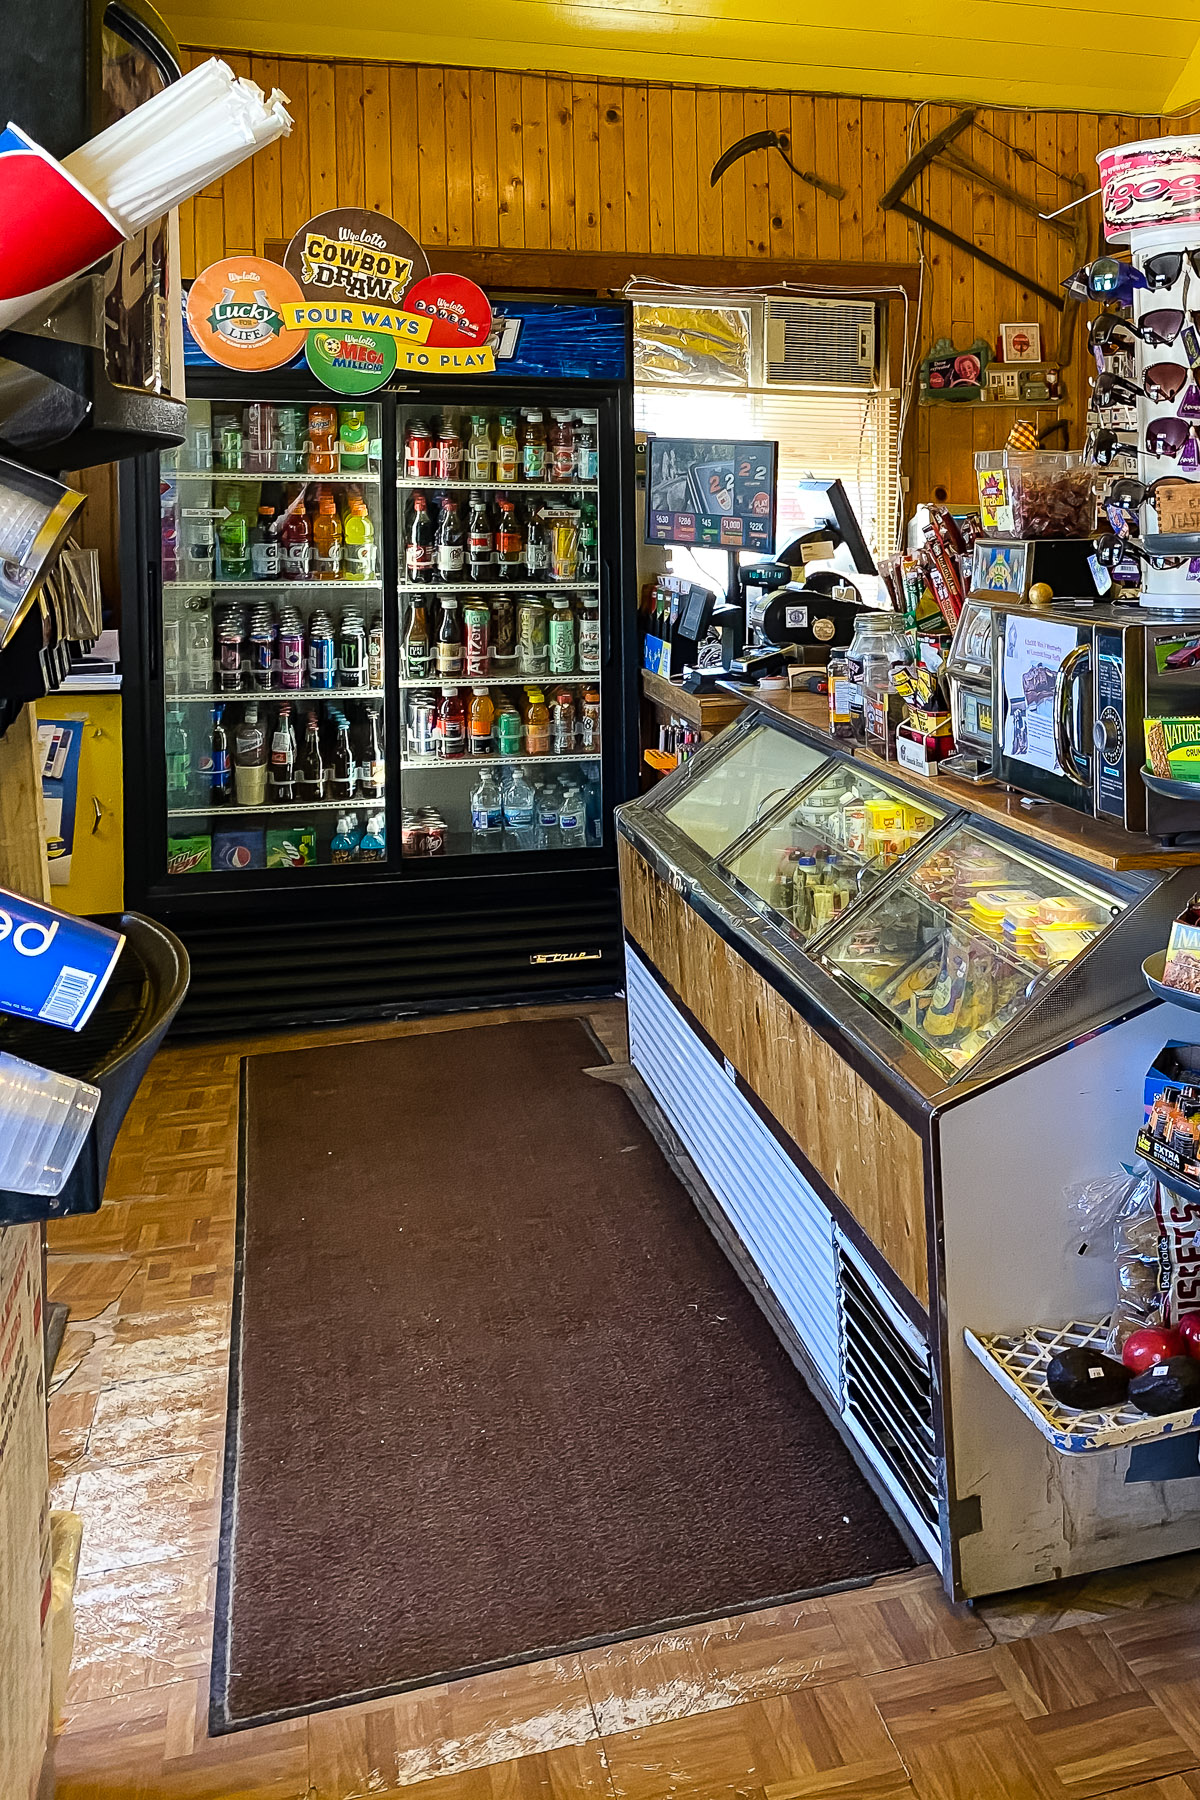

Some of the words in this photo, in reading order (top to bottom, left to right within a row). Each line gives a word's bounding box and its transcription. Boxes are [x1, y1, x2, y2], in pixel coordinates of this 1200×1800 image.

[306, 238, 411, 279] COWBOY
[314, 264, 392, 301] DRAW
[213, 302, 276, 324] Lucky
[294, 307, 353, 325] FOUR
[361, 312, 420, 337] WAYS
[414, 300, 472, 329] POWER
[228, 326, 264, 341] LIFE
[338, 341, 386, 365] MEGA
[405, 352, 431, 366] TO
[439, 352, 488, 368] PLAY
[331, 357, 385, 374] MILLIONS
[1153, 1143, 1181, 1164] EXTRA
[1153, 1151, 1180, 1170] STRENGTH
